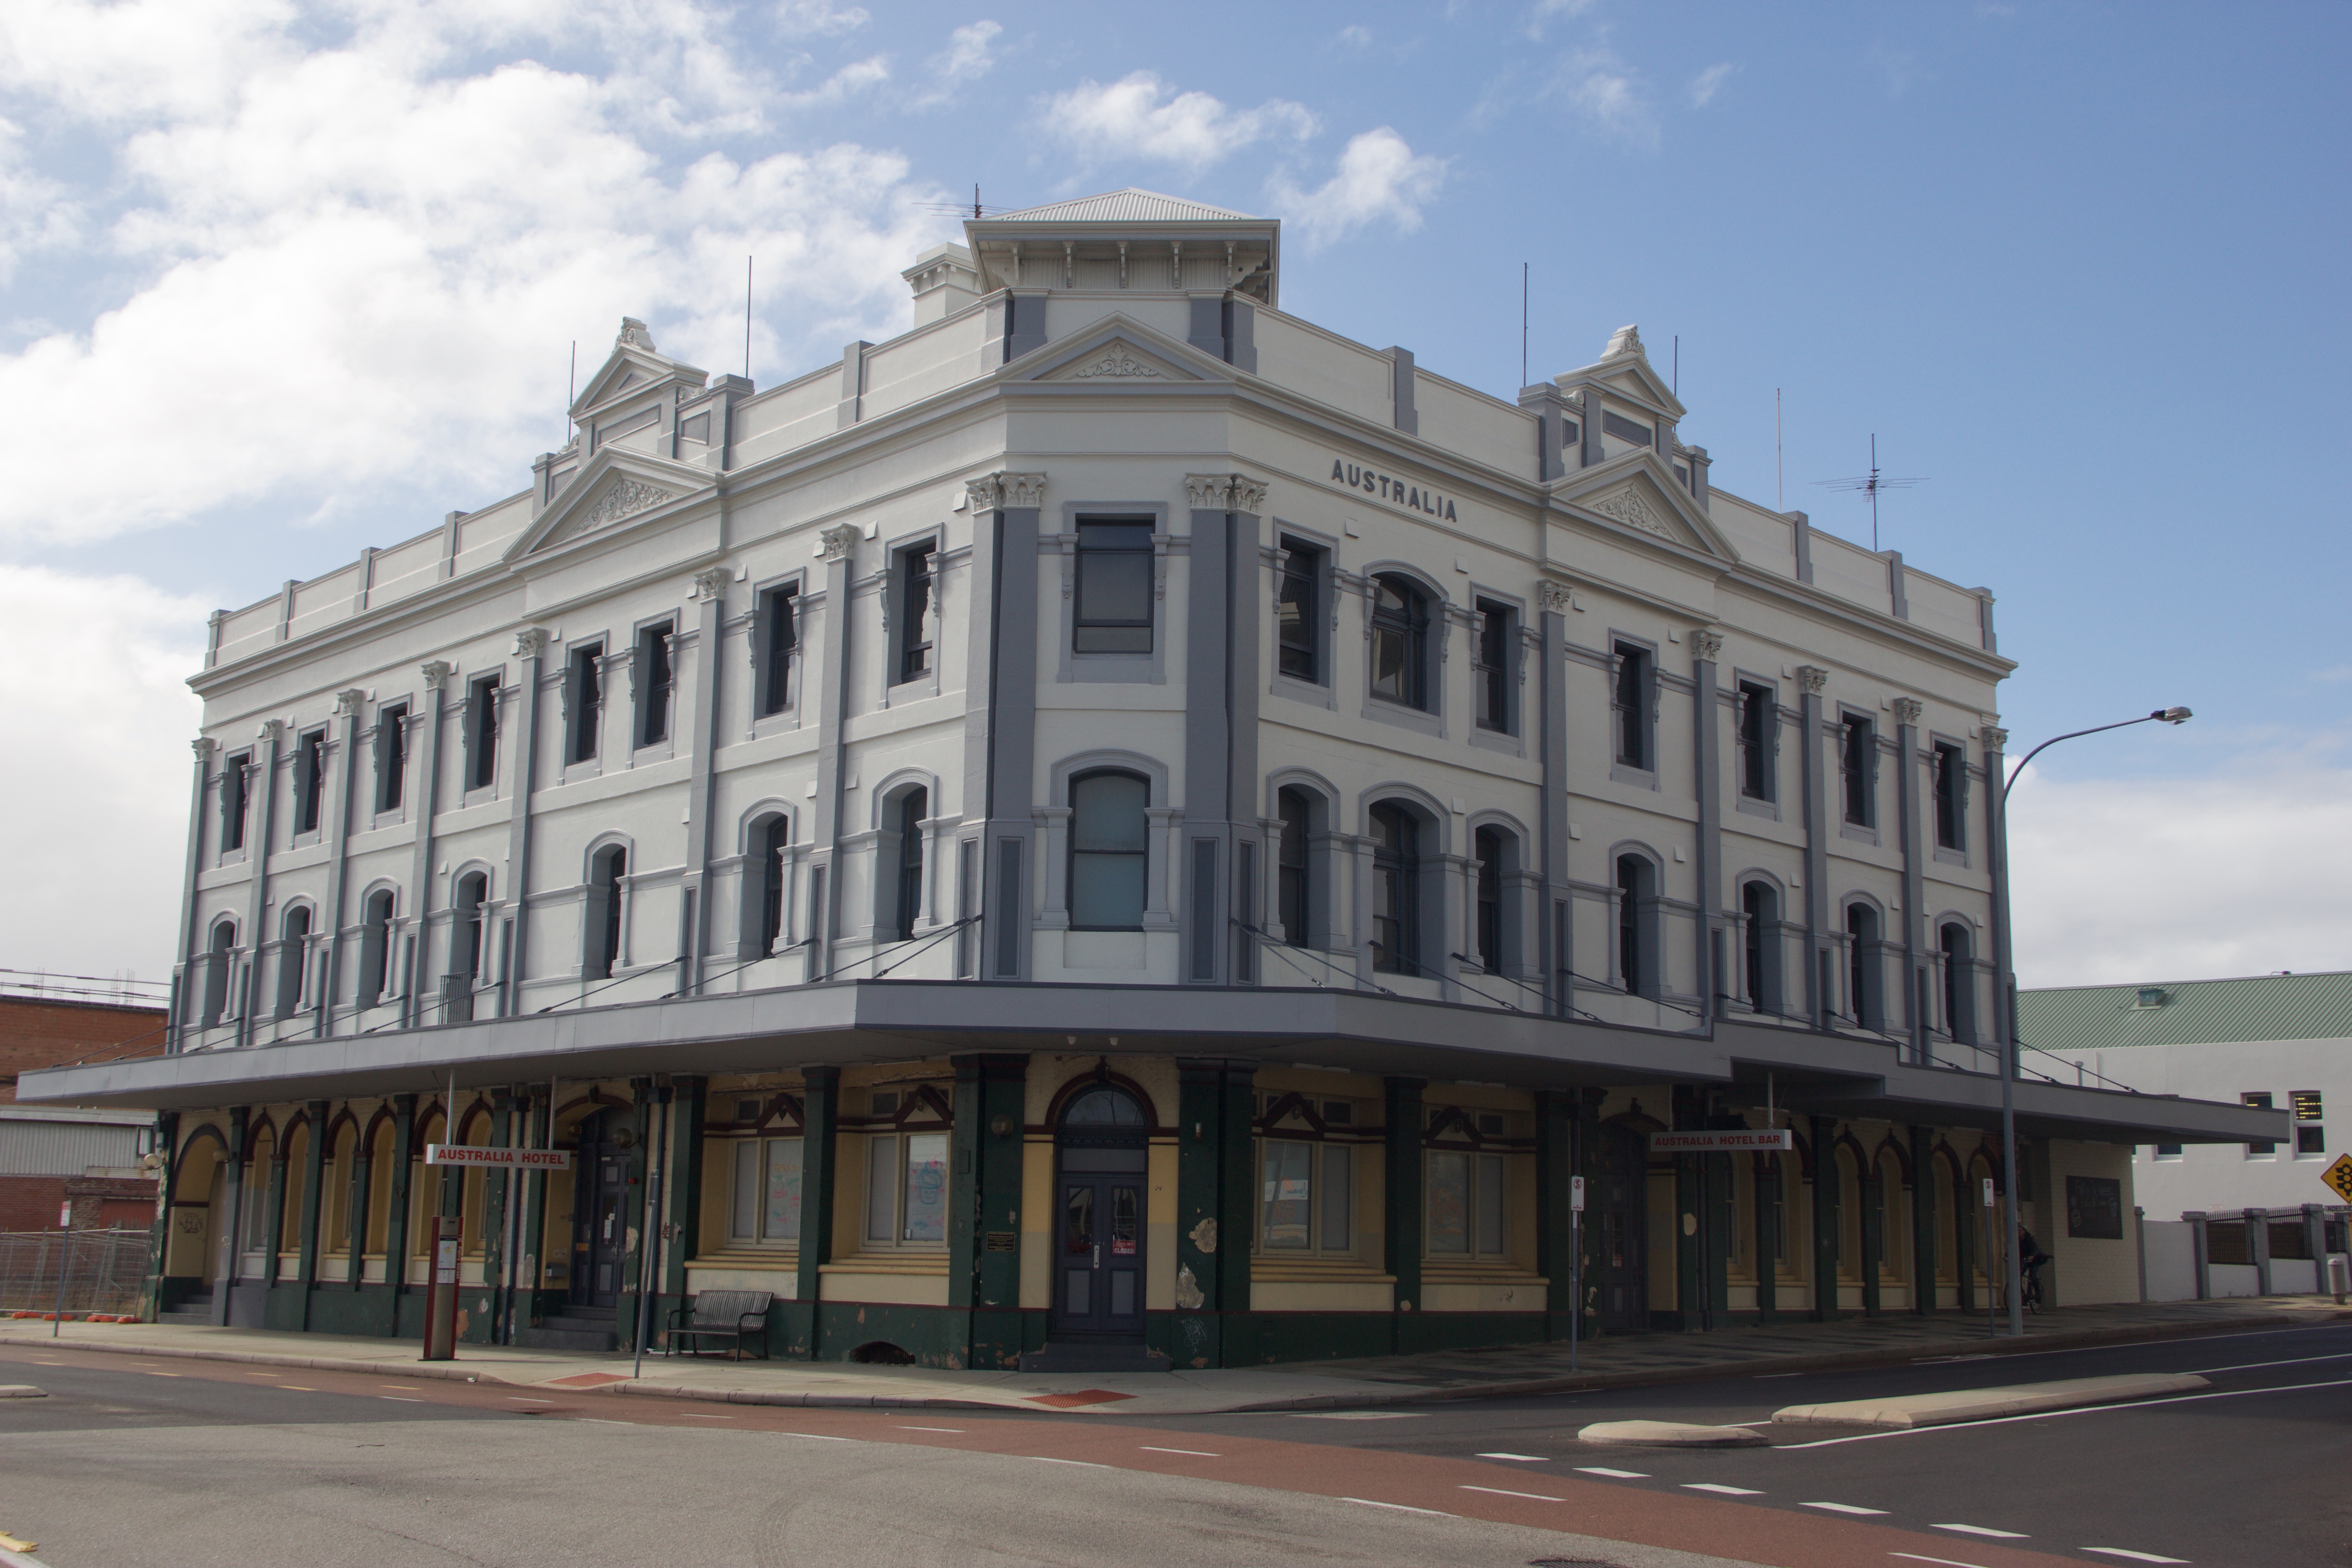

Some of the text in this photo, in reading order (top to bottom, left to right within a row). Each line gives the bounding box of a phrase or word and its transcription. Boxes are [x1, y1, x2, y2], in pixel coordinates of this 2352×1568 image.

[1332, 459, 1457, 523] AUSTRALIA
[1655, 1135, 1780, 1146] AUSTRALIA HOTEL BAR
[438, 1149, 564, 1165] AUSTRALIA HOTEL
